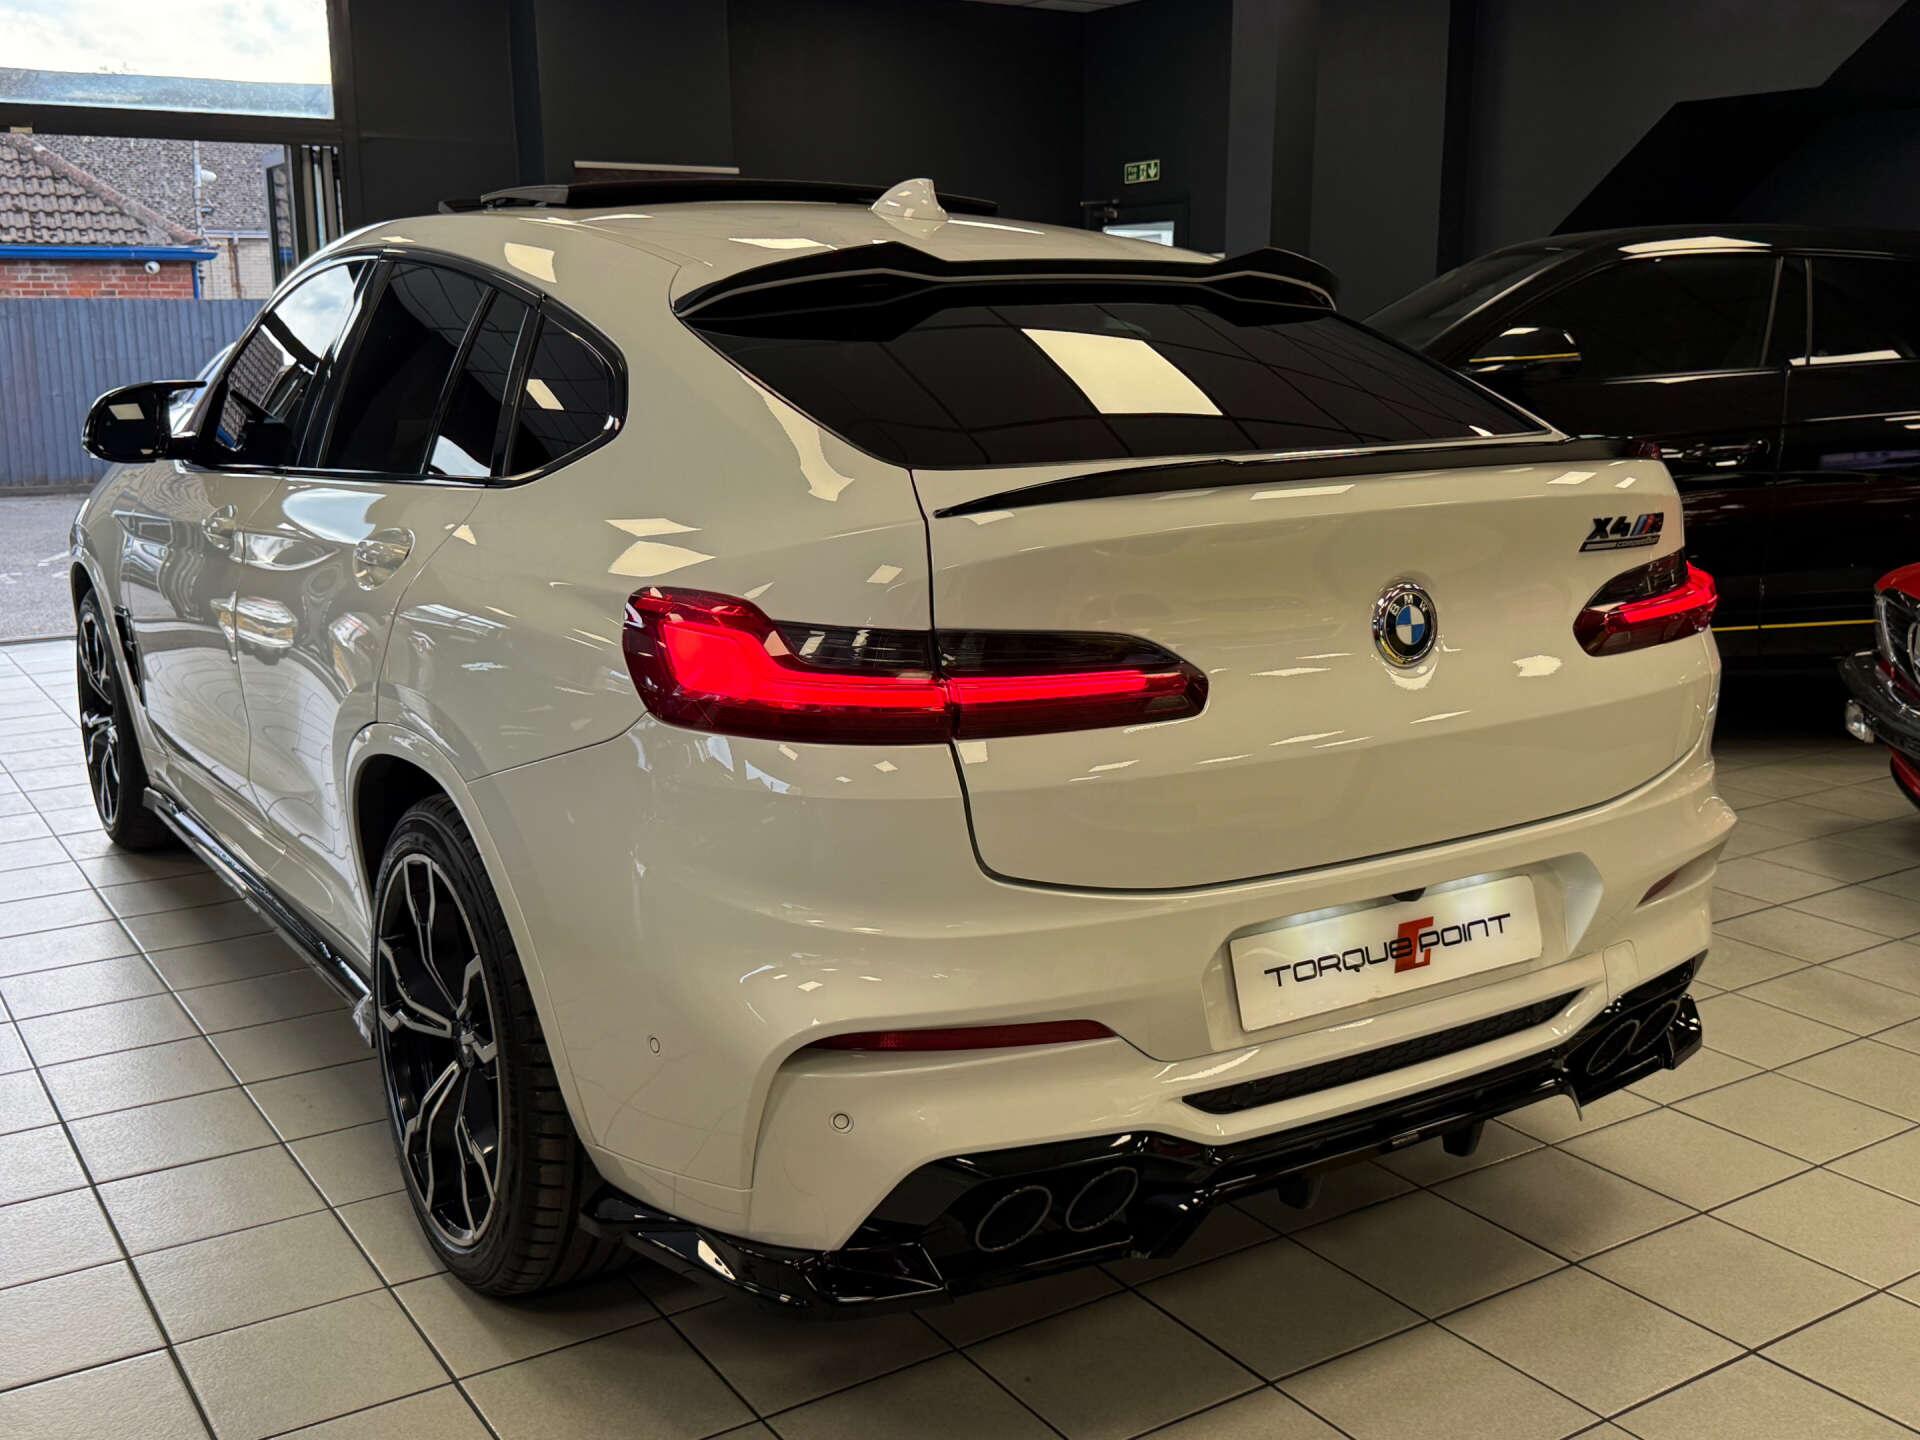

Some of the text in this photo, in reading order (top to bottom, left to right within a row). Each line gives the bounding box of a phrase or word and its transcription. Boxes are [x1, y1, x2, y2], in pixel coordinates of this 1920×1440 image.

[1390, 594, 1427, 616] BMW
[1264, 913, 1511, 987] TORQUE POINT
